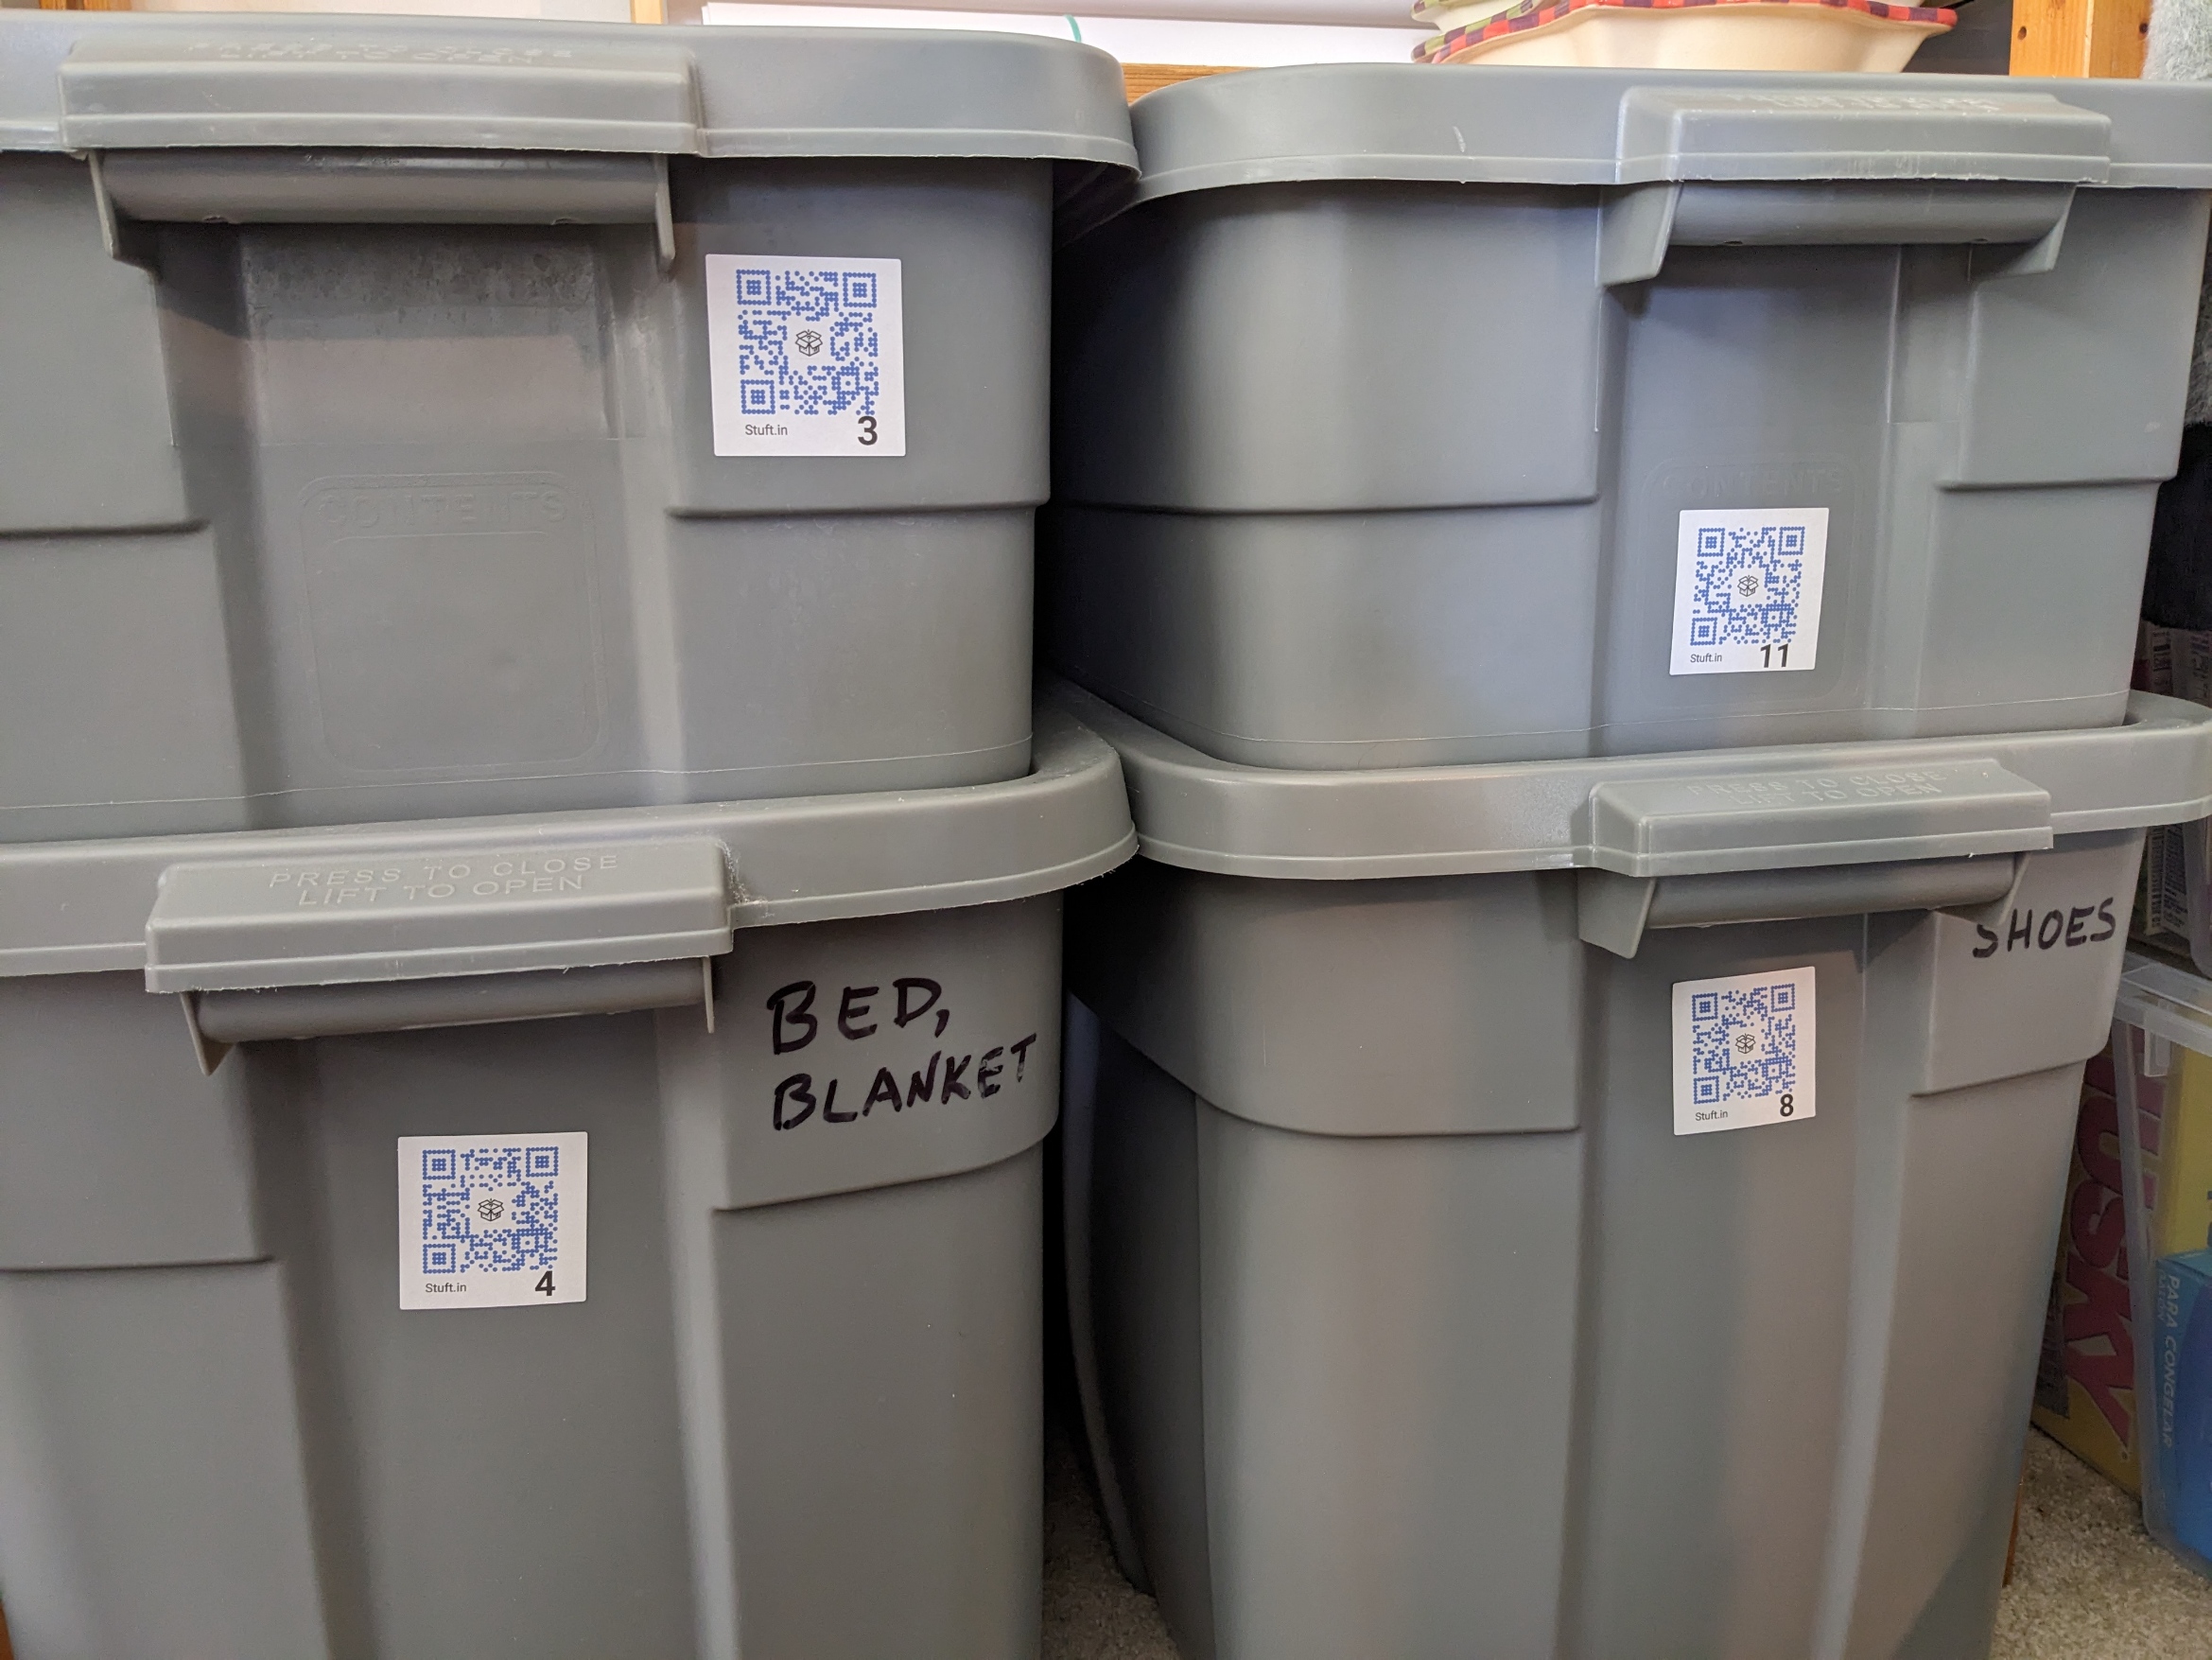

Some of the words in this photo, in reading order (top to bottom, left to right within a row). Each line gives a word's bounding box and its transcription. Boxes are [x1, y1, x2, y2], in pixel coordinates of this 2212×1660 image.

[744, 424, 789, 436] Stuft.in
[857, 415, 879, 446] 3
[1689, 653, 1723, 664] Stuft.in
[1760, 643, 1789, 669] 11
[1686, 779, 1789, 796] PRESS
[1795, 777, 1839, 790] TO
[1848, 770, 1948, 787] CLOSE
[1729, 792, 1795, 806] LIFT
[1802, 789, 1848, 803] TO
[1855, 782, 1942, 798] OPEN
[269, 866, 402, 889] PRESS
[423, 863, 472, 882] TO
[493, 854, 619, 878] CLOSE
[298, 886, 388, 907] LIFT
[403, 882, 456, 901] TO
[472, 874, 584, 896] OPEN
[1972, 897, 2116, 958] SHOES
[766, 977, 950, 1056] BED,
[773, 1032, 1037, 1131] BLANKET
[1695, 1110, 1729, 1122] Stuft.in
[1779, 1092, 1794, 1117] 8
[425, 1282, 467, 1293] Stuft.in
[534, 1270, 556, 1297] 4
[2167, 1273, 2181, 1328] PARA
[2162, 1335, 2177, 1449] CONGELAR
